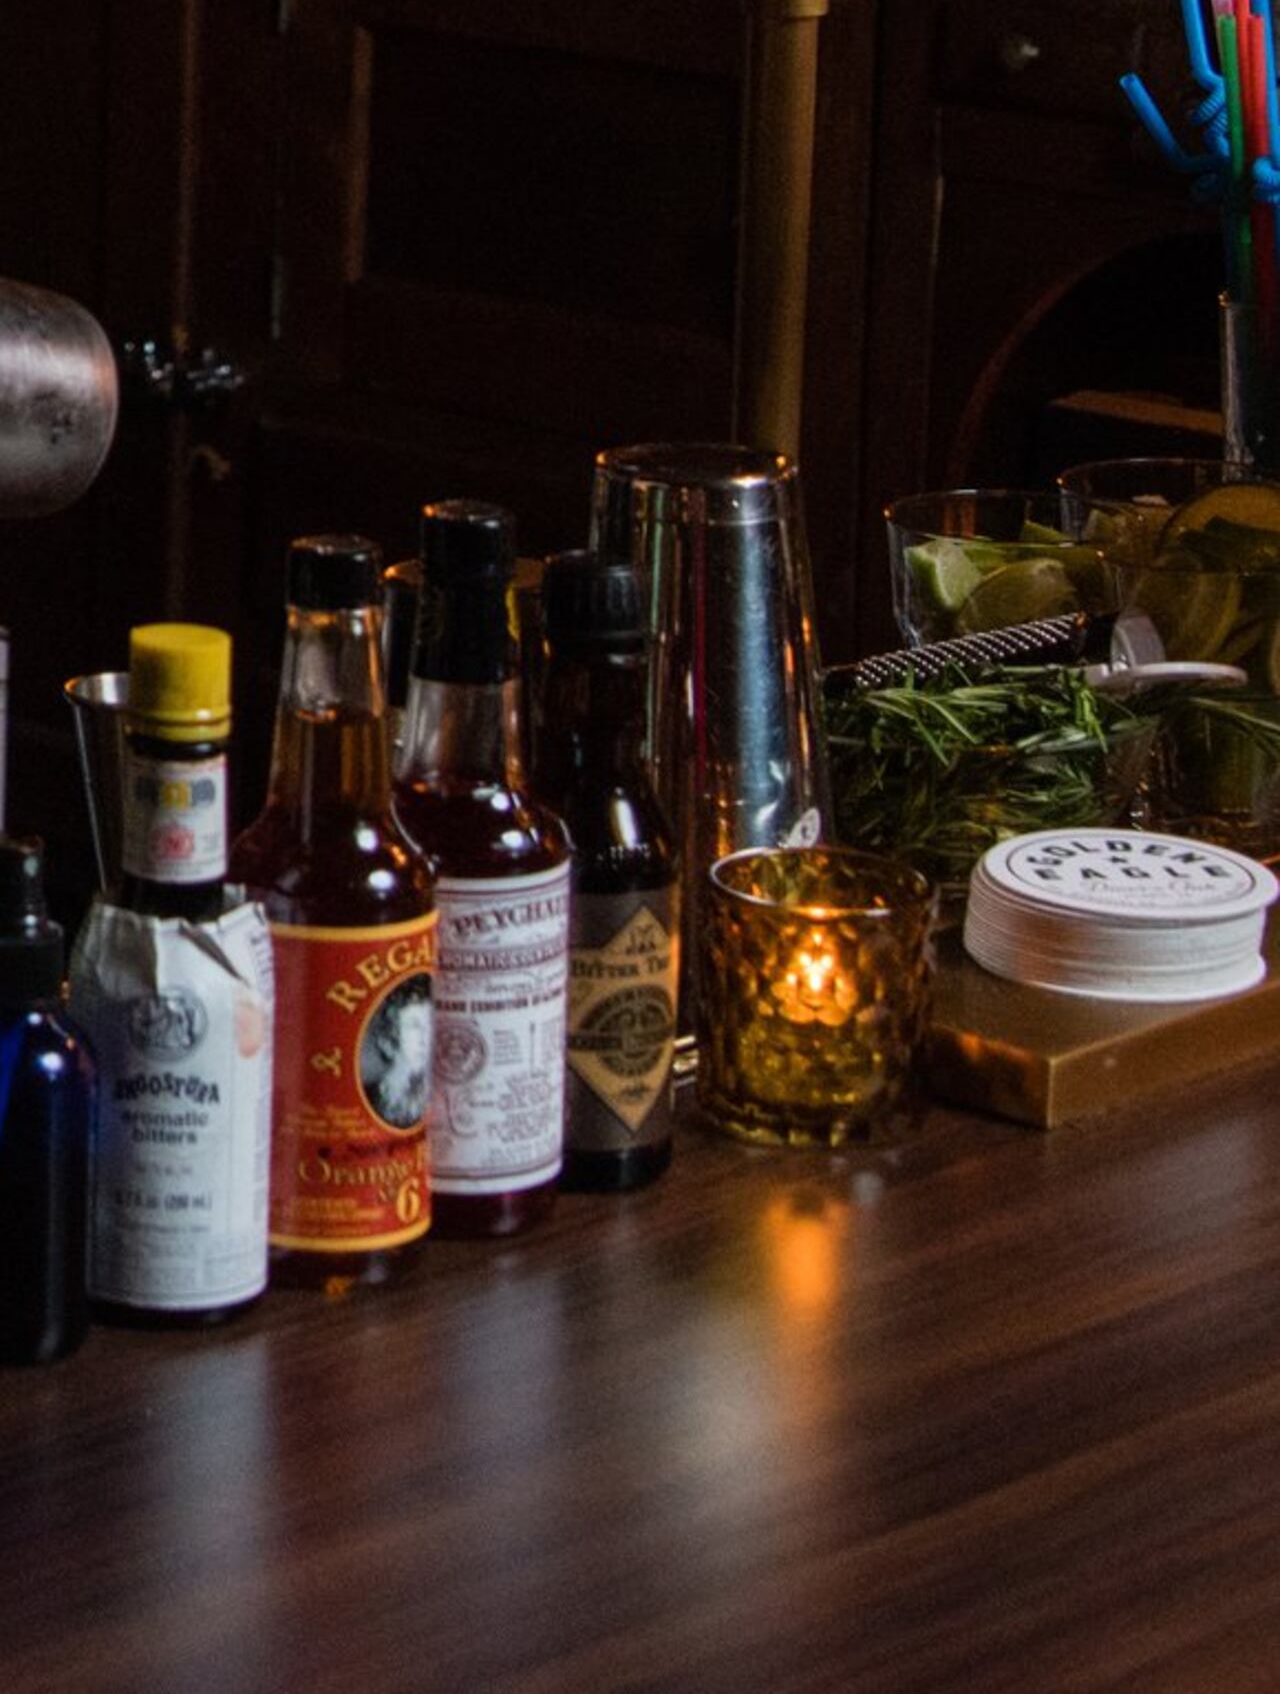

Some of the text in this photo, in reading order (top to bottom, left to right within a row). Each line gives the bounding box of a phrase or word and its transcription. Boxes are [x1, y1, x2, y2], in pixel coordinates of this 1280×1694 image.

[1026, 838, 1208, 867] GOLDEN
[1034, 863, 1233, 882] EAGLE
[115, 1071, 222, 1105] ANGOSTURA
[122, 1108, 210, 1127] aromatic
[130, 1128, 199, 1145] bitters
[395, 1176, 421, 1224] 6
